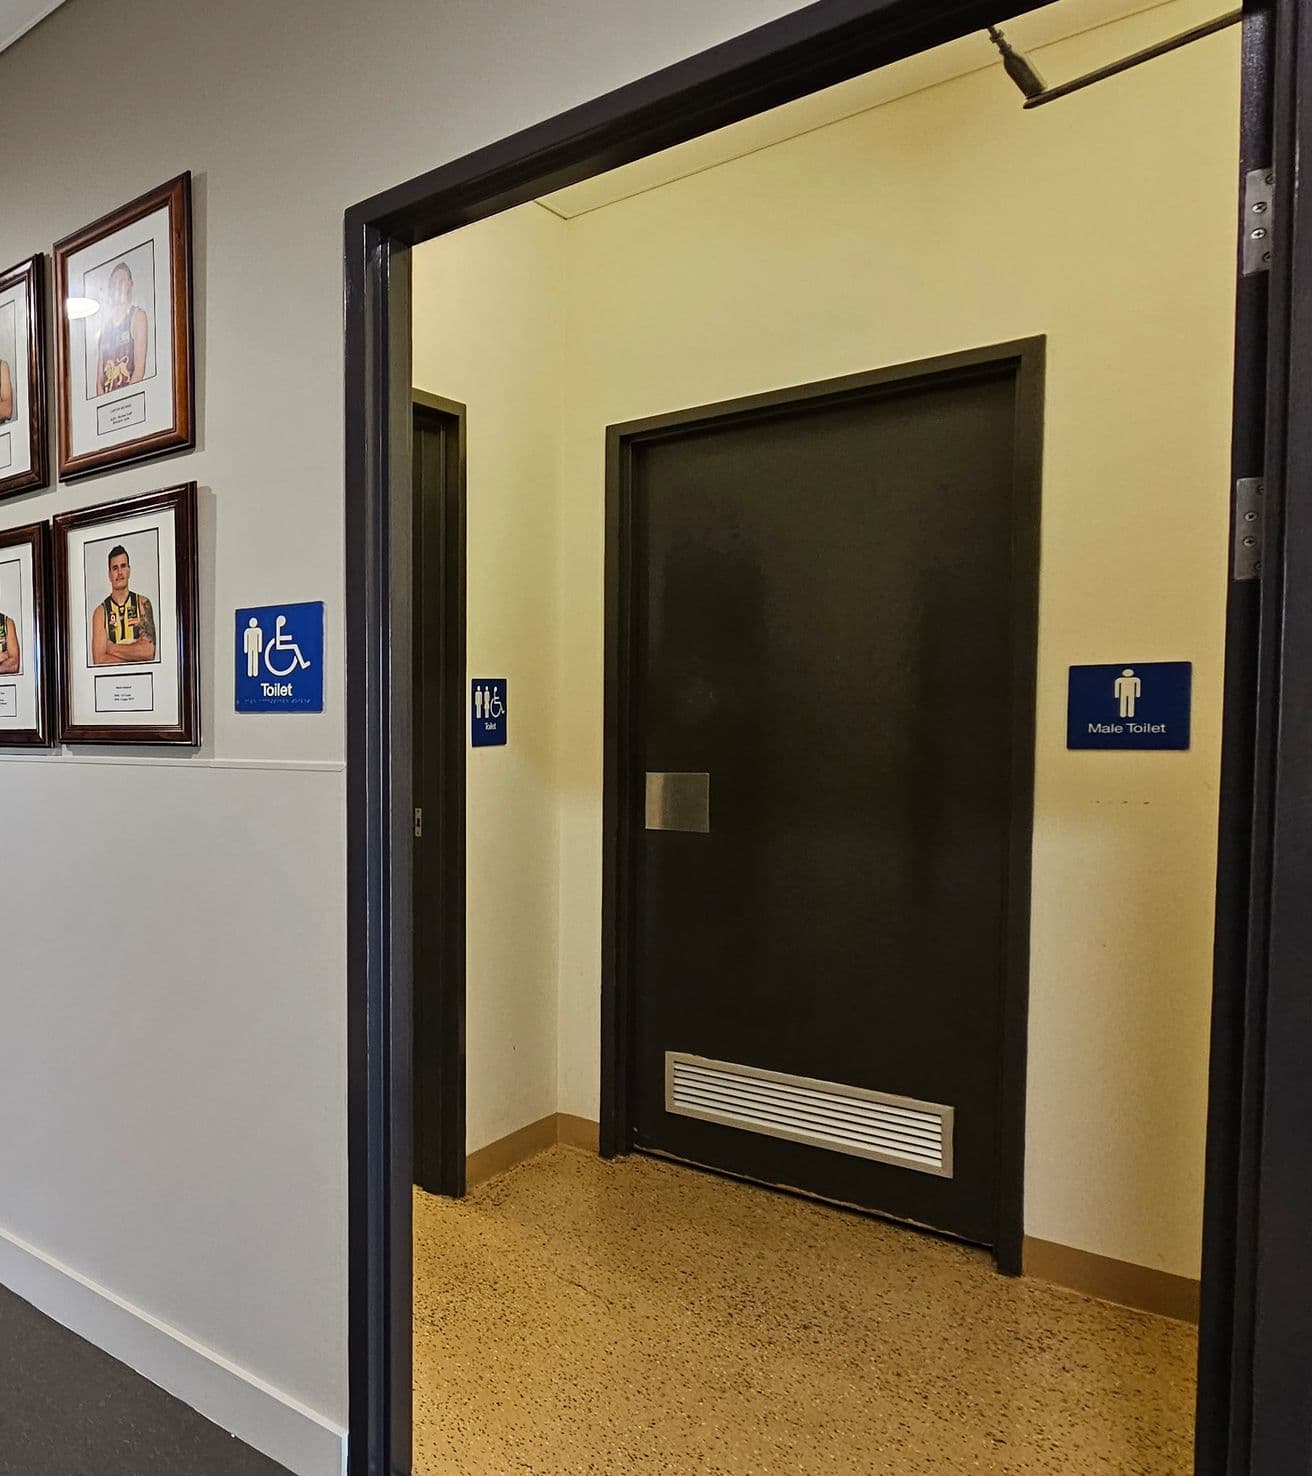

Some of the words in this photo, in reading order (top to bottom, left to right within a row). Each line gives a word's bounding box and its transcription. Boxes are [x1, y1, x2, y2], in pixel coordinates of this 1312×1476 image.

[260, 682, 293, 697] Toilet
[1088, 723, 1124, 734] Male
[1125, 723, 1167, 734] Toilet
